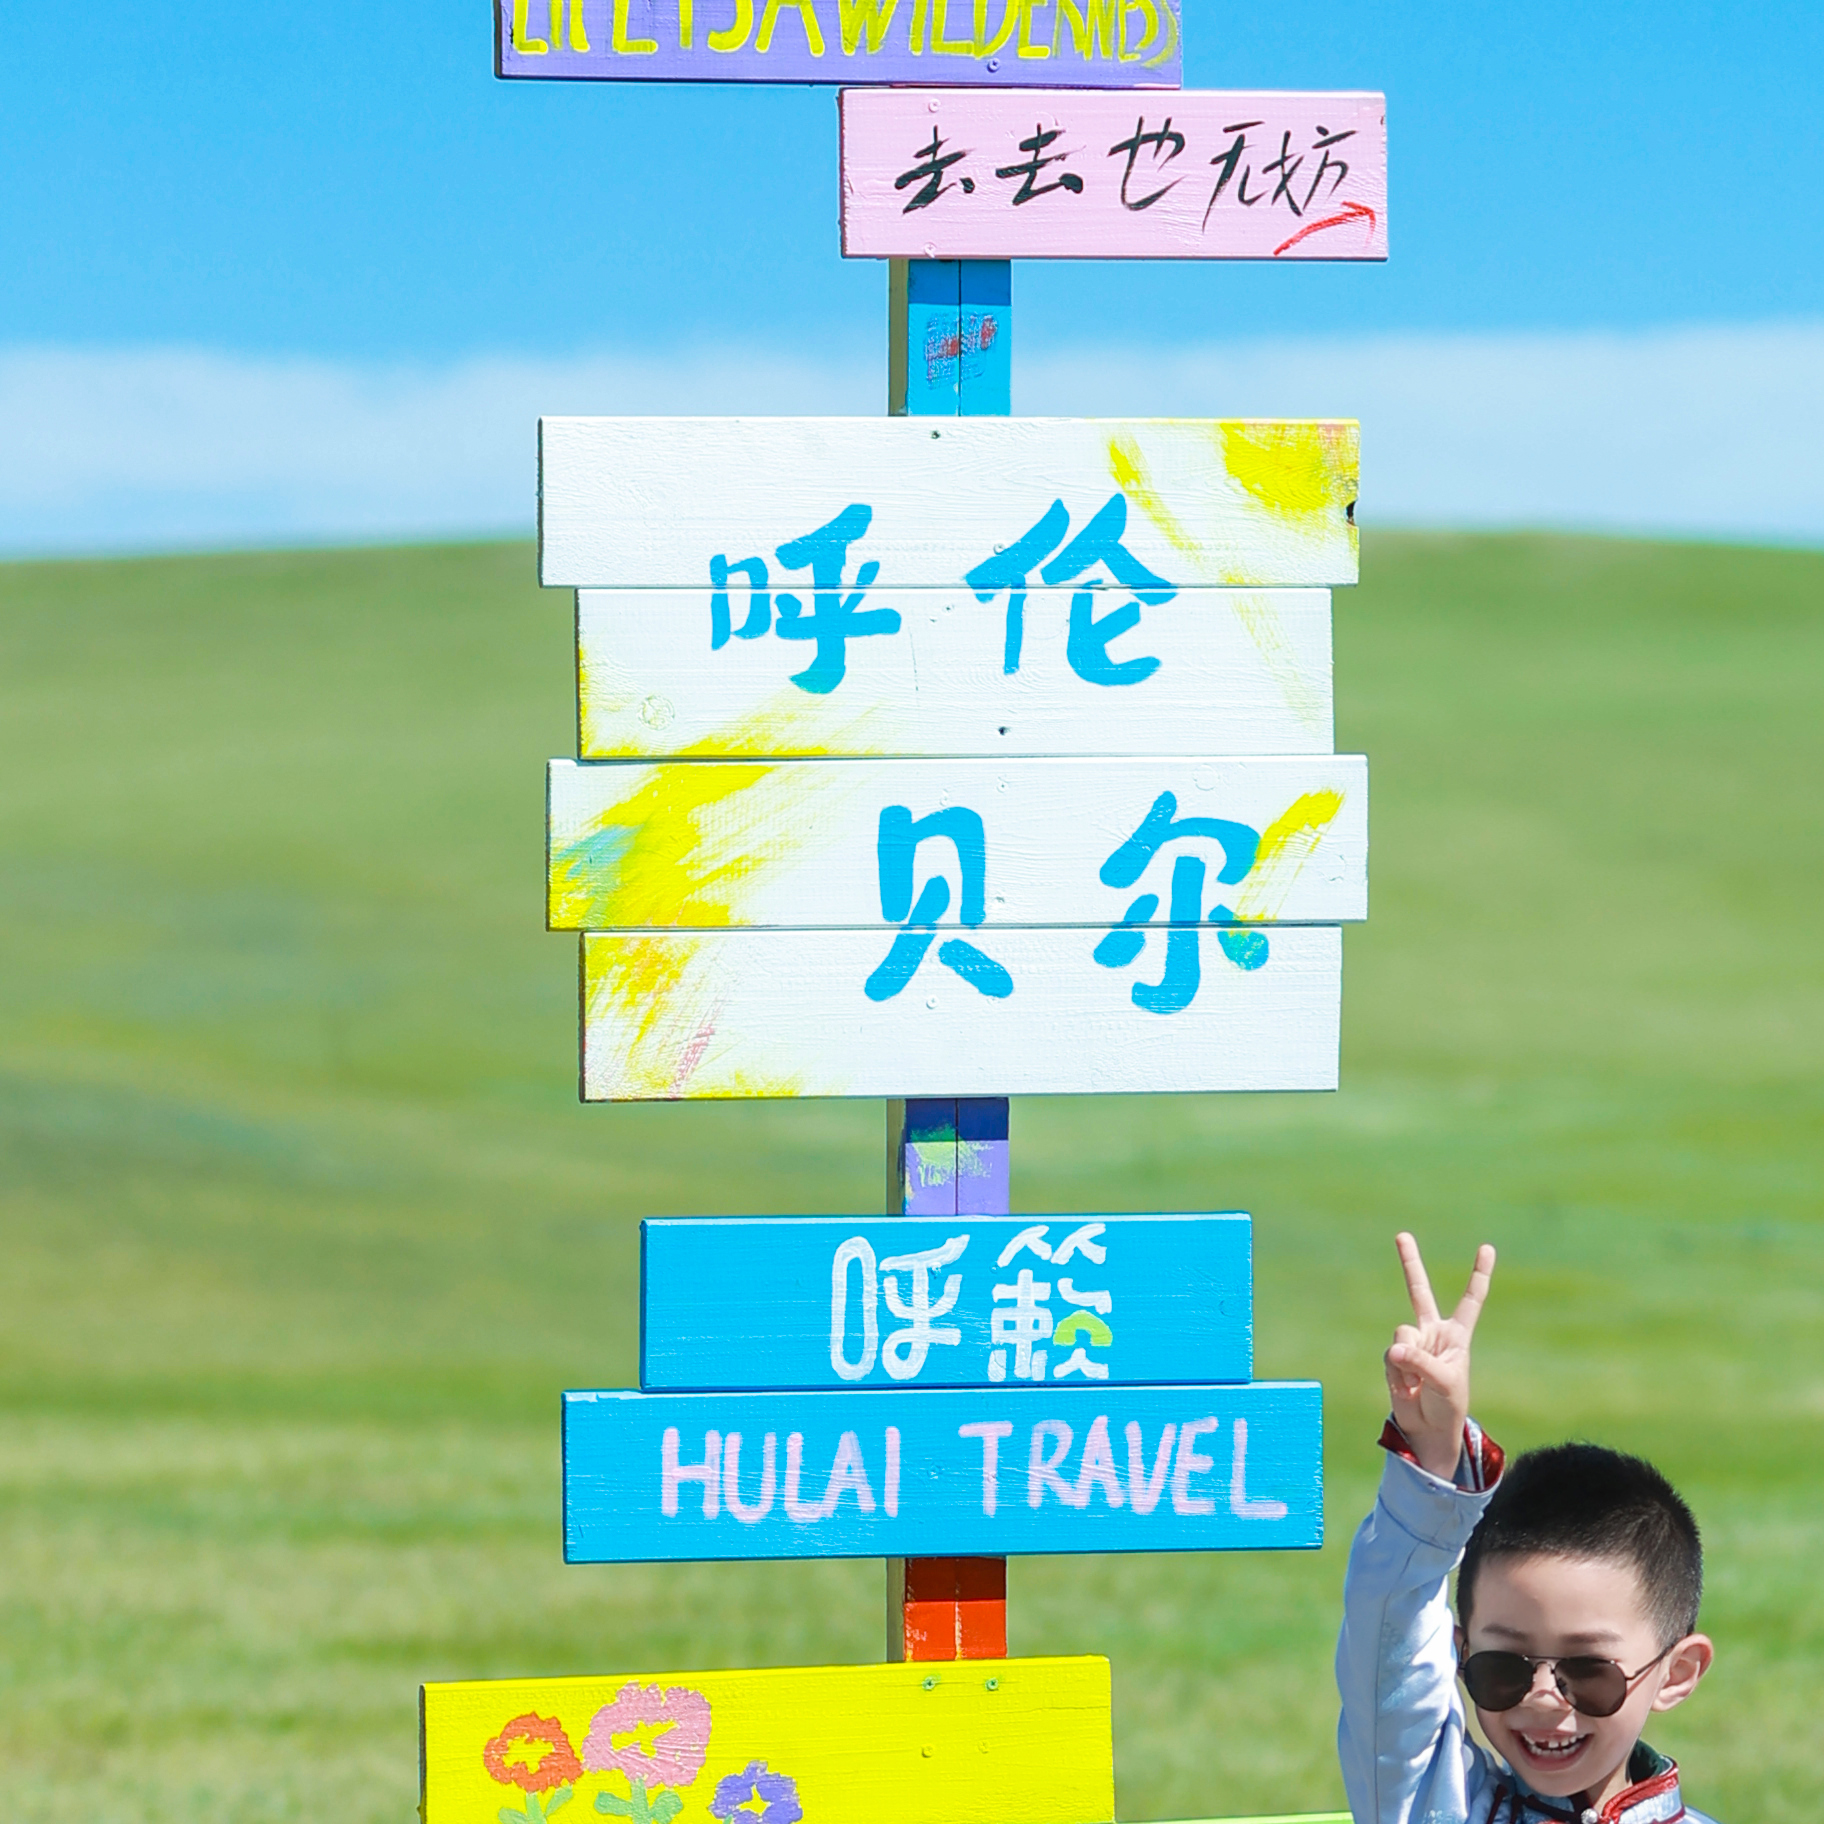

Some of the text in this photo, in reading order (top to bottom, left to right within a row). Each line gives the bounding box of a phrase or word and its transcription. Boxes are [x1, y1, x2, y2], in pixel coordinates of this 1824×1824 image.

[709, 492, 1178, 696] 呼伦
[863, 789, 1270, 1015] 贝尔
[661, 1415, 1288, 1524] HULAI TRAVEL
